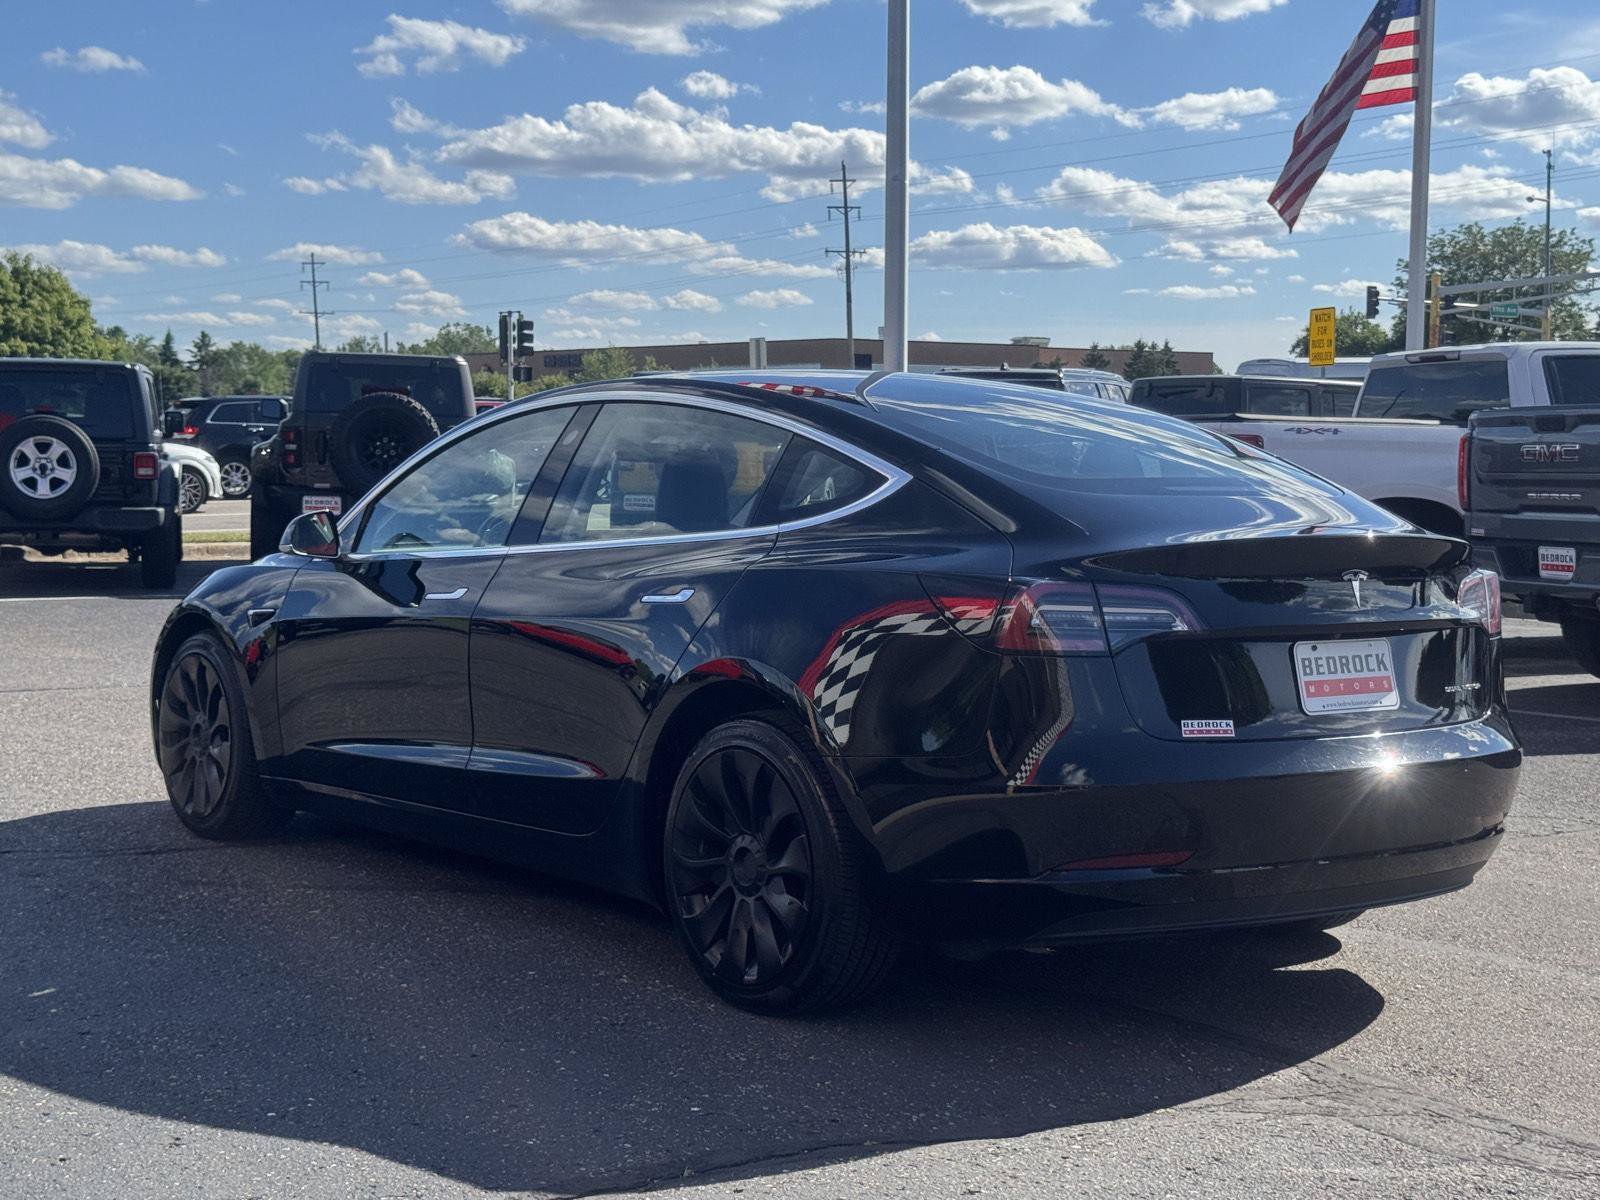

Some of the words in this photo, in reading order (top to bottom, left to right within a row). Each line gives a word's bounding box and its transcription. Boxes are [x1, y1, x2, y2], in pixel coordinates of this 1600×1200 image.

[1314, 312, 1332, 323] WATCH
[1317, 325, 1328, 337] FOR
[1520, 444, 1580, 462] GMC
[1540, 553, 1574, 564] BEDROCK
[1300, 653, 1389, 677] BEDROCK
[1308, 680, 1389, 693] MOTORS
